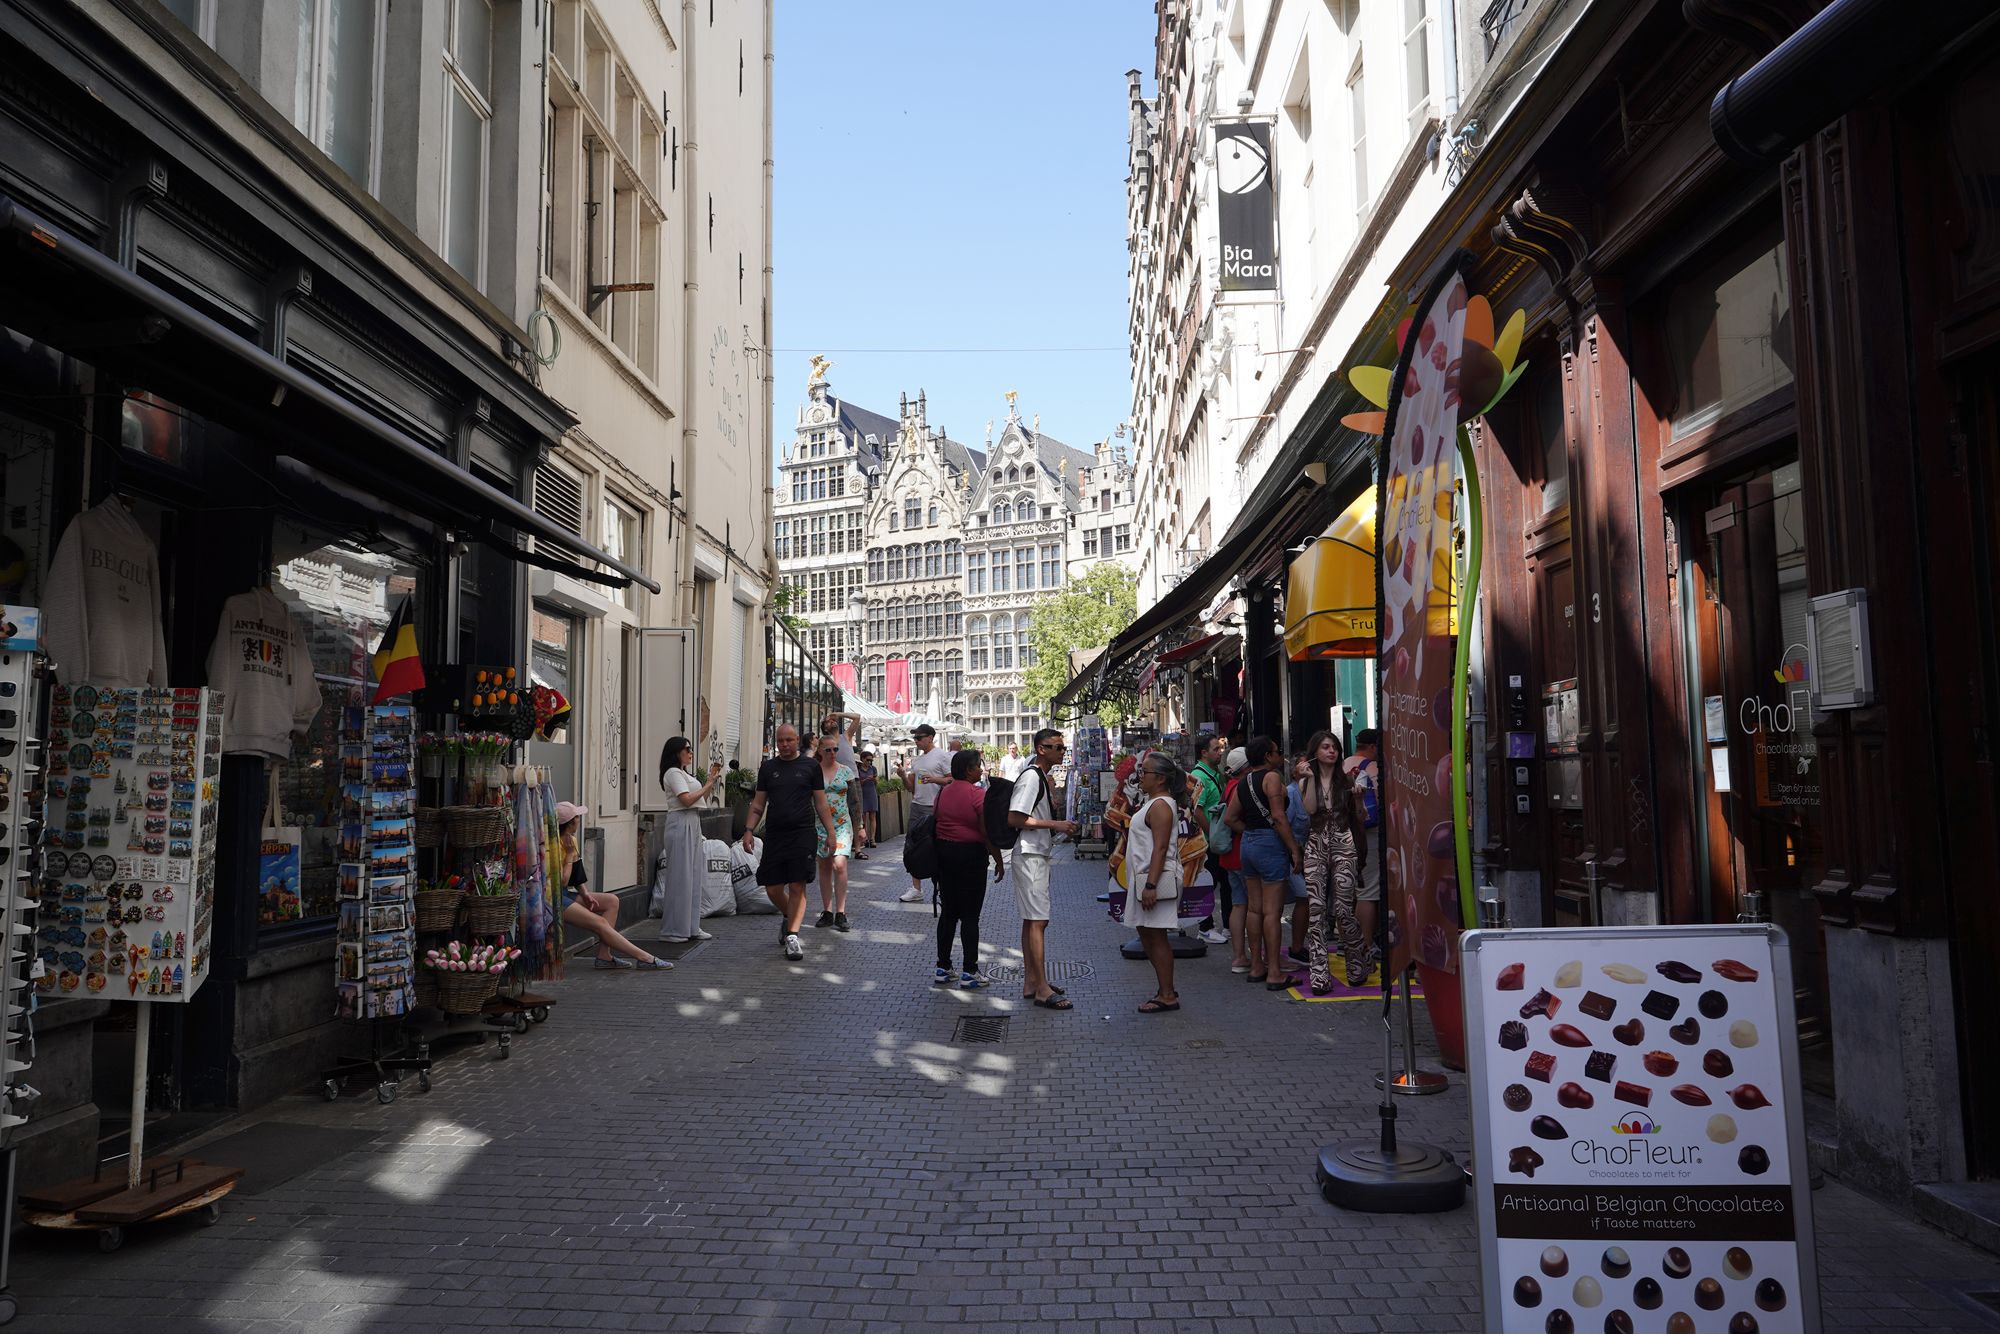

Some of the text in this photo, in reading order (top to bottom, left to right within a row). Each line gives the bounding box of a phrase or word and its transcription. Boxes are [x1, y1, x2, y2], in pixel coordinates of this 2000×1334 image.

[1223, 244, 1253, 261] Bia
[1224, 261, 1272, 278] Mara
[717, 411, 737, 448] NORD
[1592, 592, 1601, 623] 3
[243, 663, 284, 678] BELGIUM
[1516, 693, 1523, 701] 4
[1777, 783, 1793, 794] Open
[1571, 1138, 1700, 1166] ChoFleur
[1588, 1169, 1692, 1179] Chocolates to melt for
[1501, 1194, 1786, 1216] Artisanal Belgian Chocolates
[1590, 1217, 1696, 1230] if Taste matters
